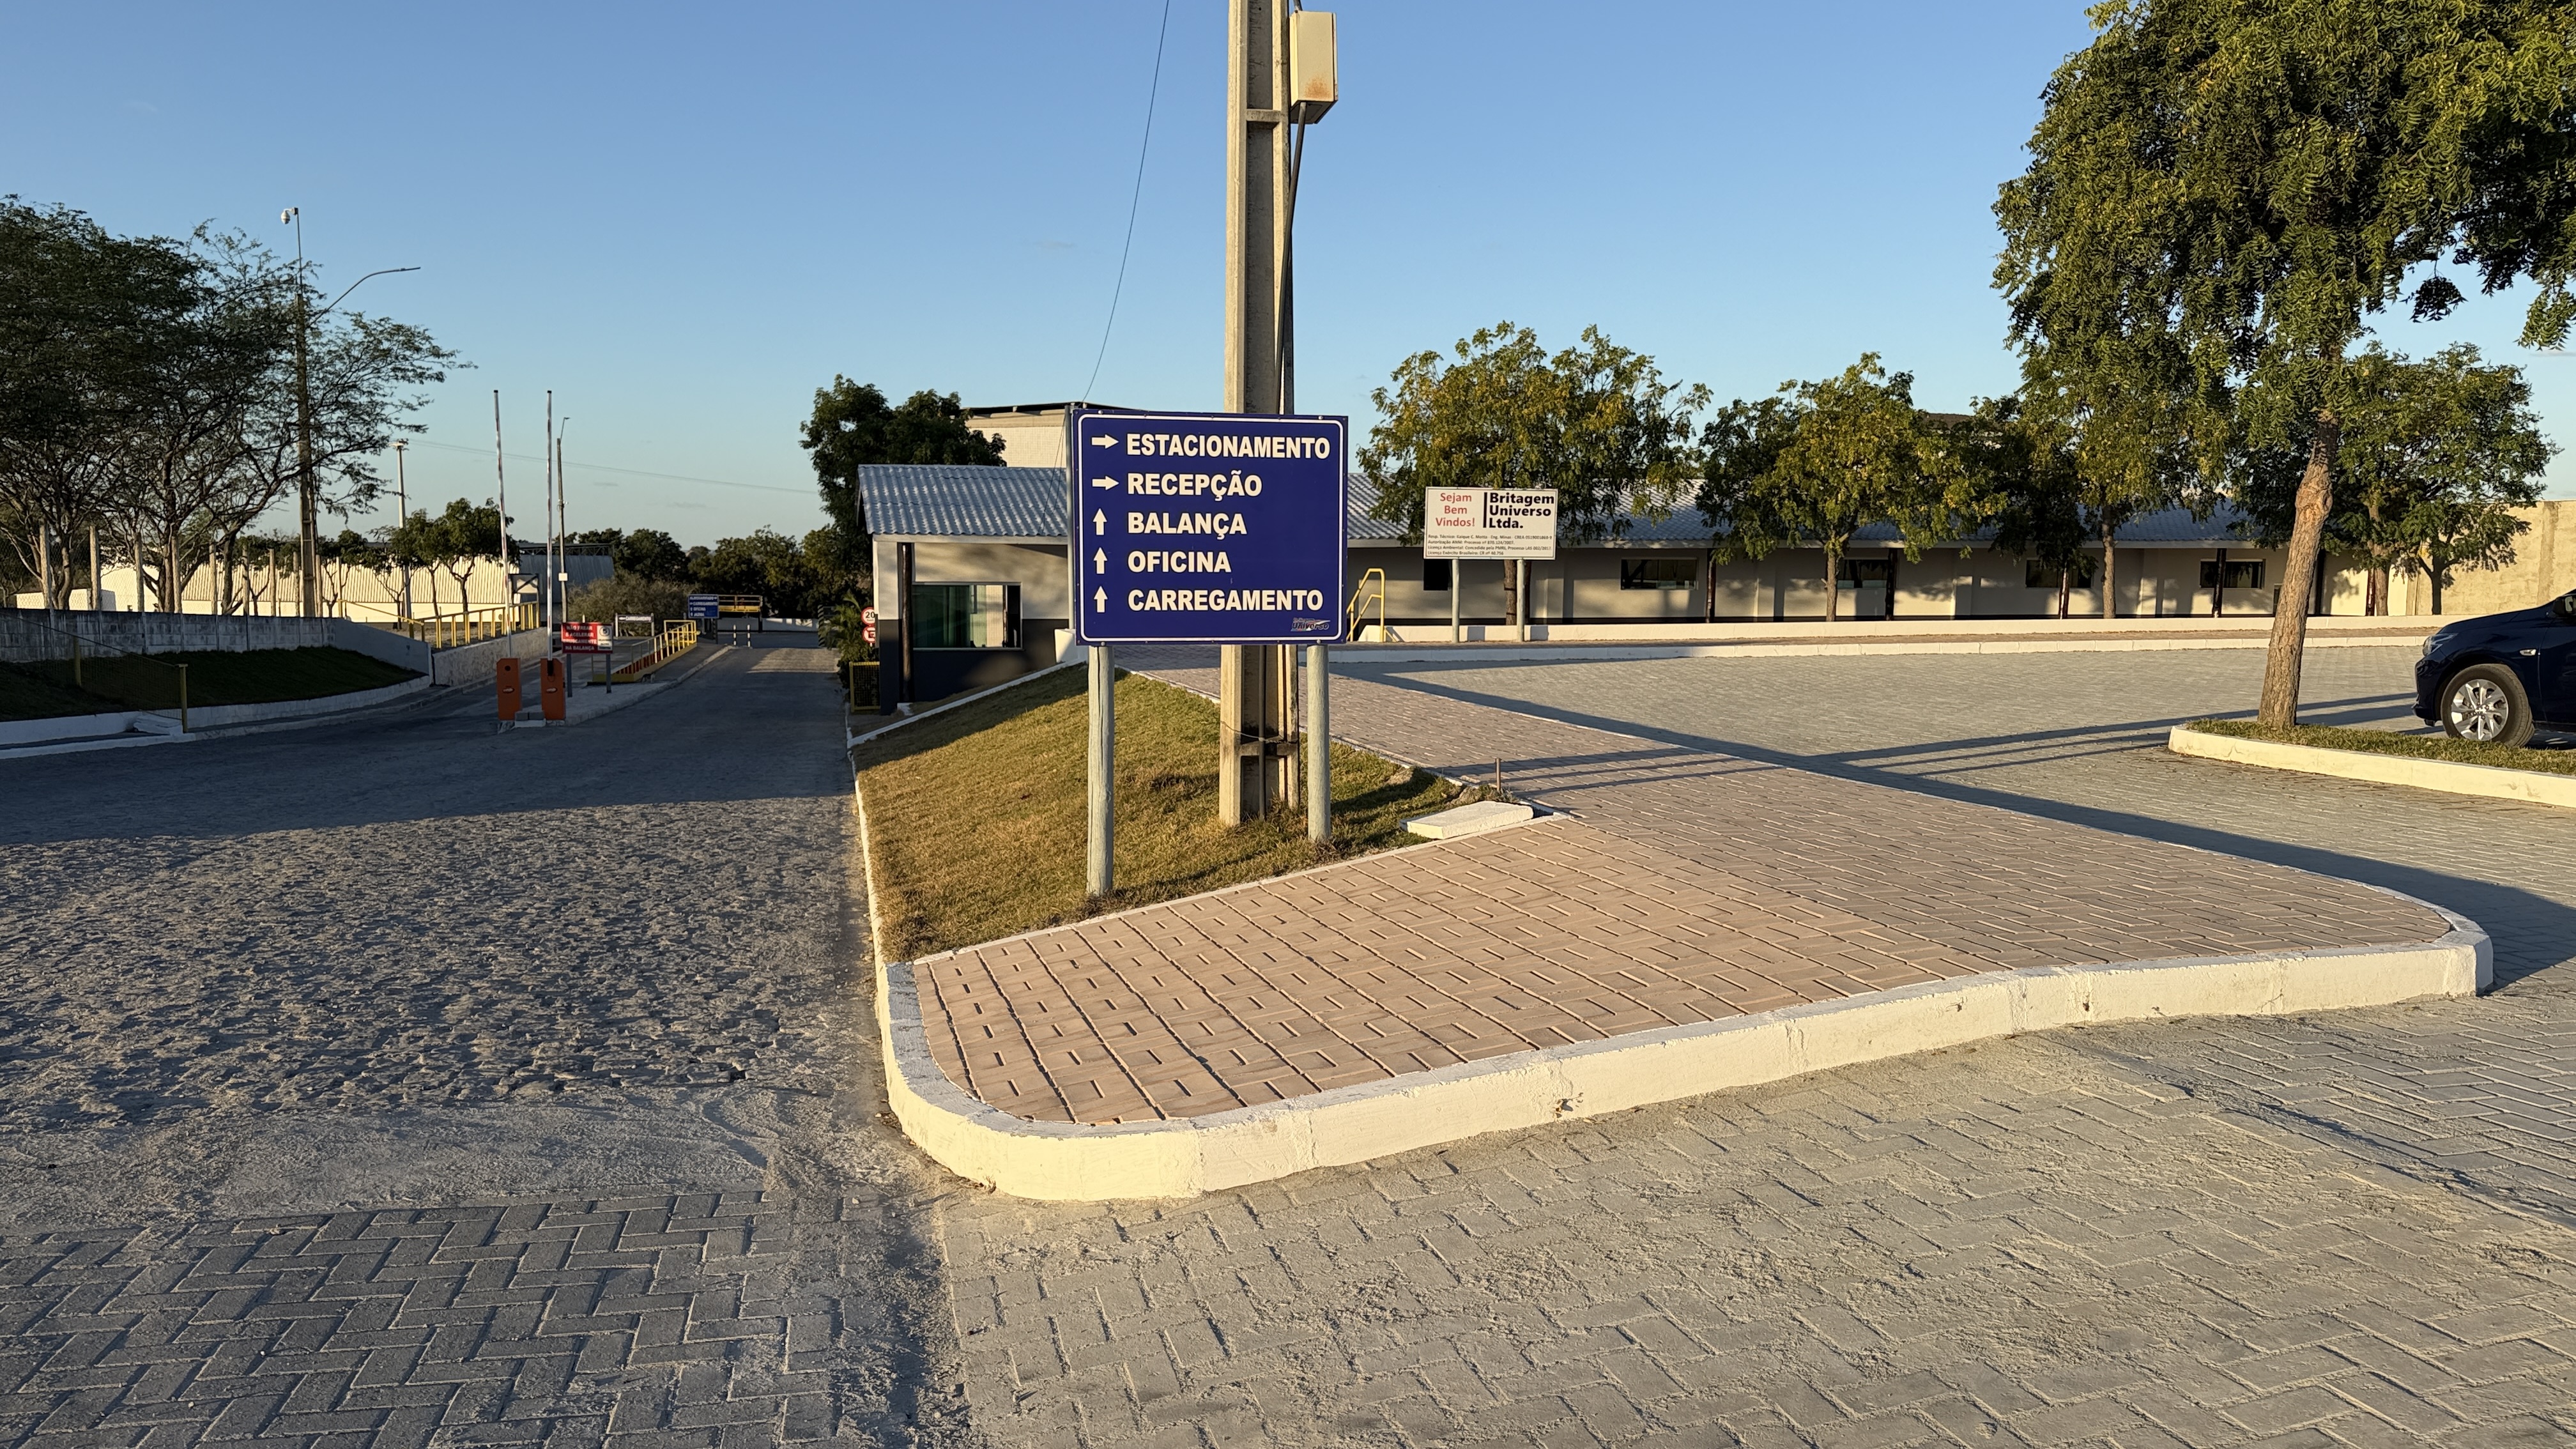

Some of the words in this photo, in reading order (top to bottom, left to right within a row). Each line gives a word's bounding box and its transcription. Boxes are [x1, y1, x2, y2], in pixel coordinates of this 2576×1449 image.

[1126, 433, 1330, 459] ESTACIONAMENTO
[1128, 470, 1262, 501] RECEPÇÃO
[1440, 493, 1472, 503] Sejam
[1490, 493, 1554, 507] Britagem
[1445, 505, 1468, 514] Bem
[1490, 505, 1551, 516] Universo
[1128, 512, 1247, 540] BALANÇA
[1436, 518, 1475, 527] Vindos!
[1489, 518, 1523, 529] Ltda.
[1128, 551, 1232, 573] OFICINA
[1128, 589, 1324, 611] CARREGAMENTO
